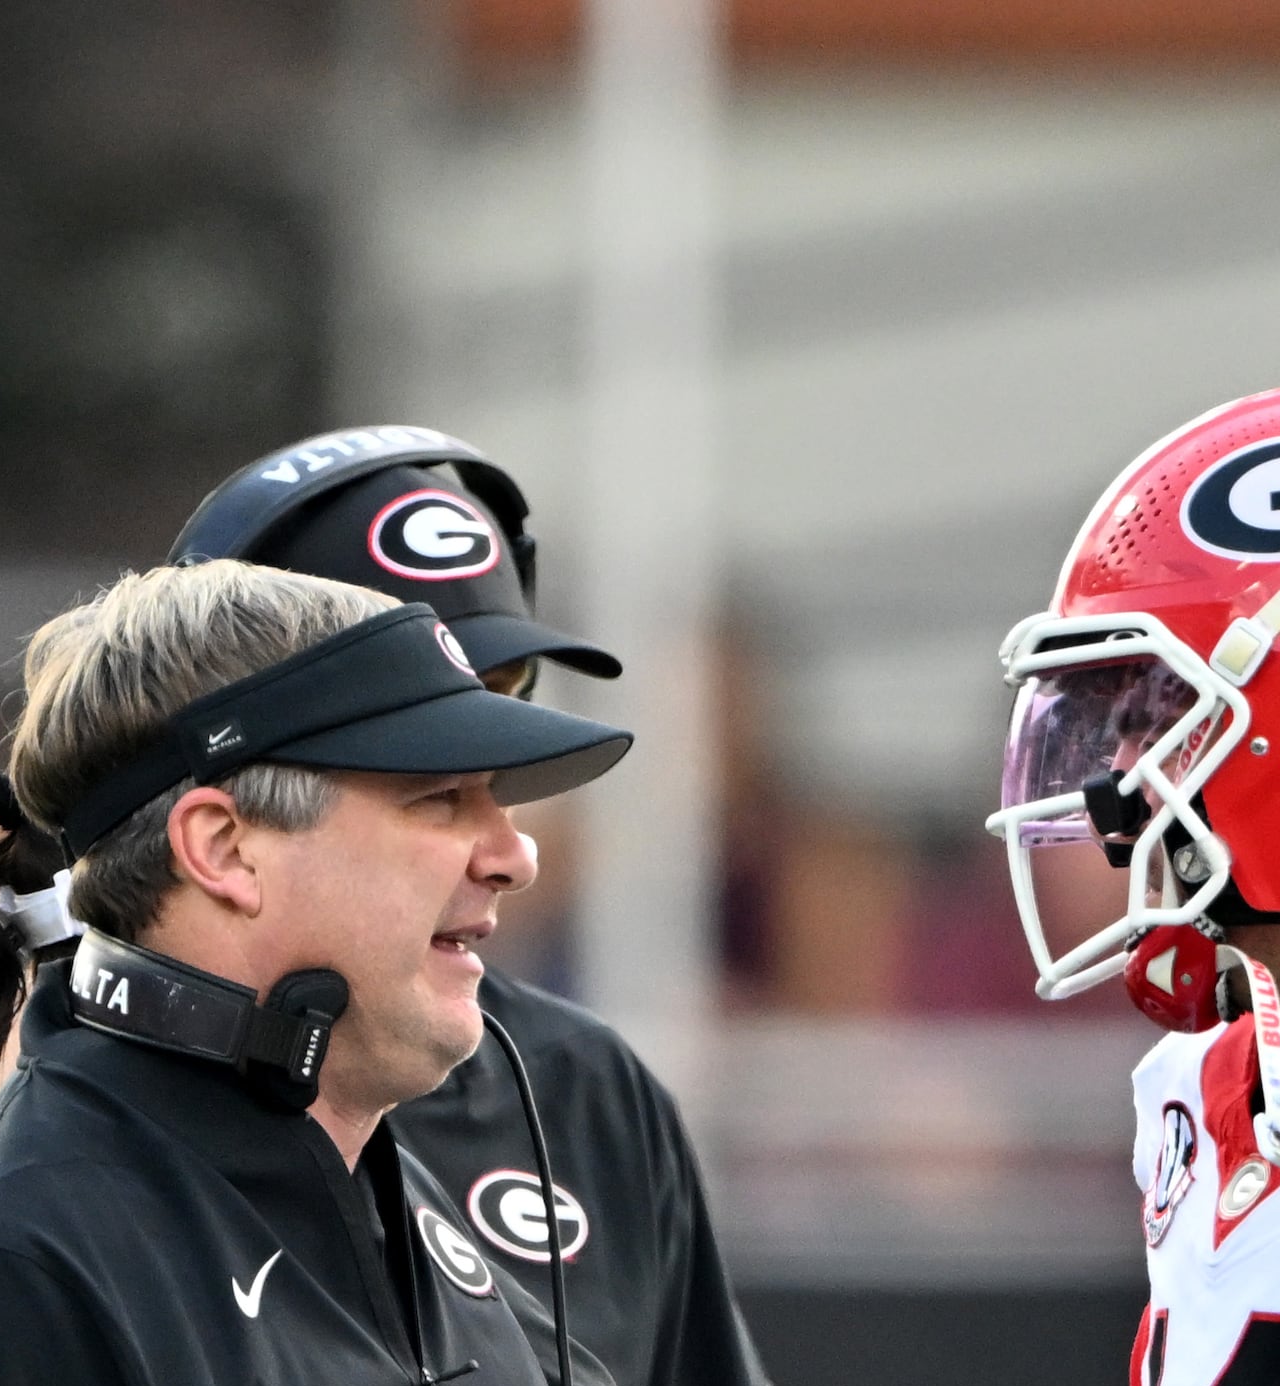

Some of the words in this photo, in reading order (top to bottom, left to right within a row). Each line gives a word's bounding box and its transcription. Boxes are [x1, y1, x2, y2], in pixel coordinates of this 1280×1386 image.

[379, 499, 491, 571] G
[422, 1213, 488, 1288] G
[479, 1179, 580, 1253] G
